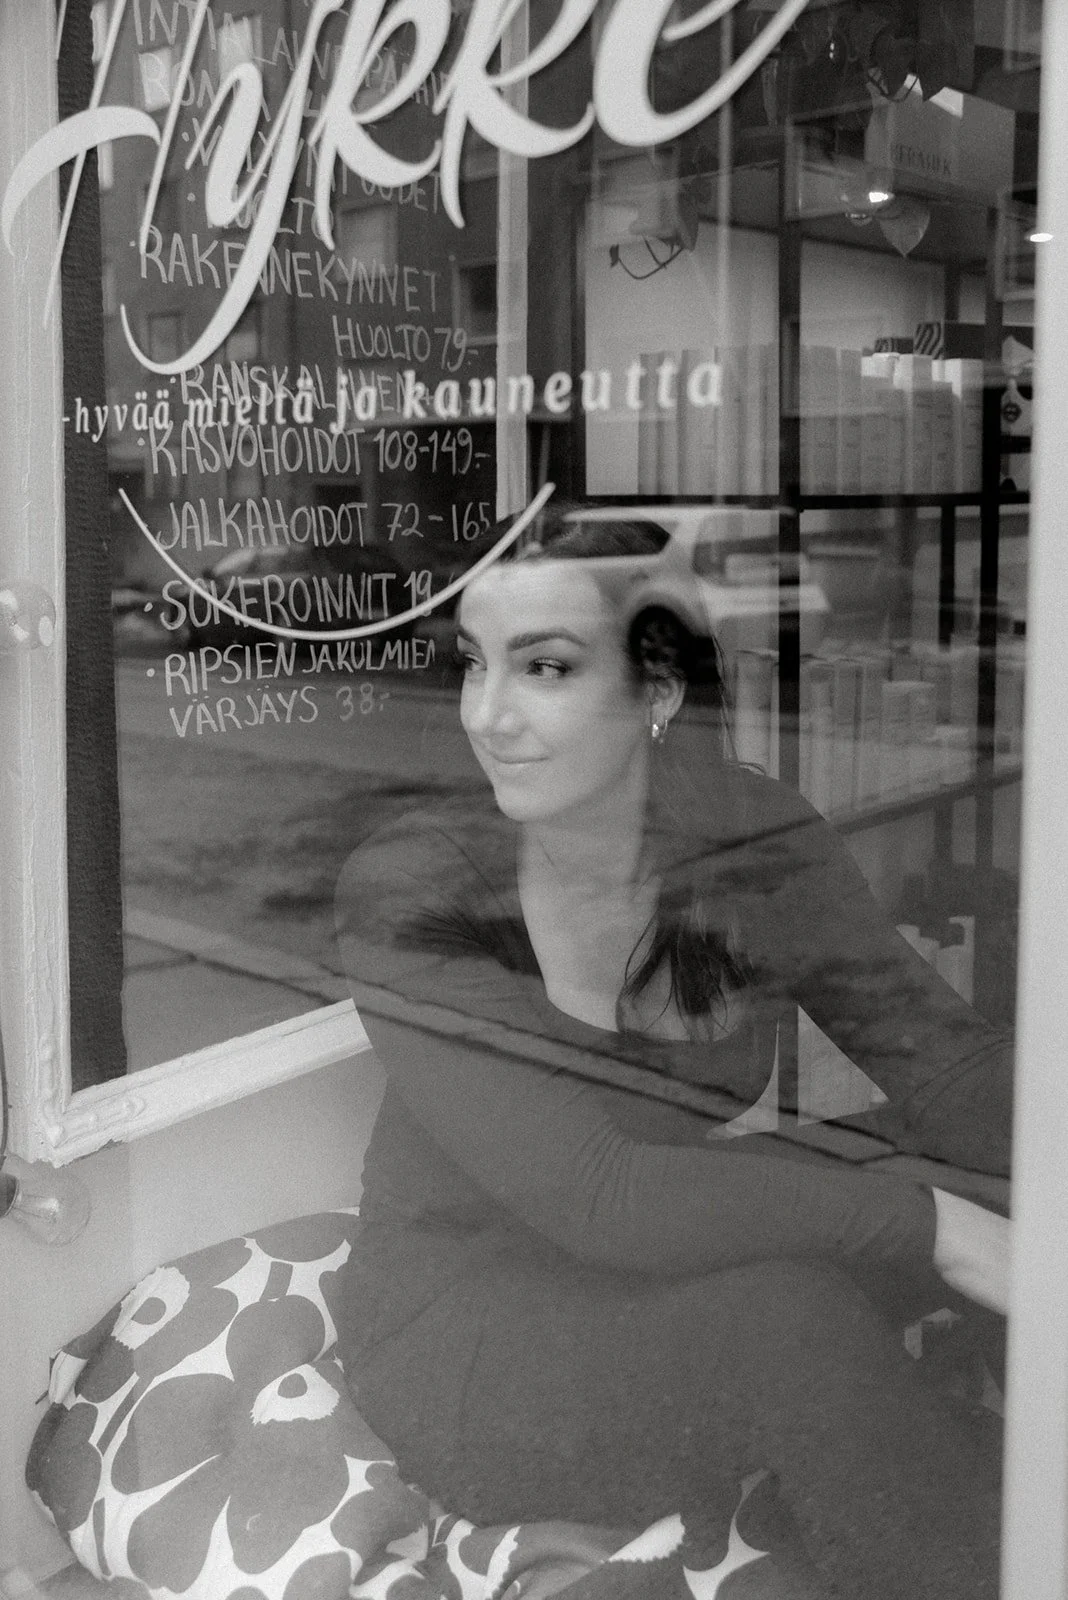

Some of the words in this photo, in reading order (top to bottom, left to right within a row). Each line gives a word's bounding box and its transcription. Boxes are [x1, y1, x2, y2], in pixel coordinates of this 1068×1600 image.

[332, 315, 431, 363] HUOLTO
[329, 372, 377, 434] ja
[402, 361, 723, 420] kauneutta
[149, 416, 366, 477] KASVOHOIDOT
[156, 497, 369, 551] JALKAHOIDOT
[164, 641, 298, 697] RIPSIEN
[168, 684, 320, 738] VÄRJÄYS
